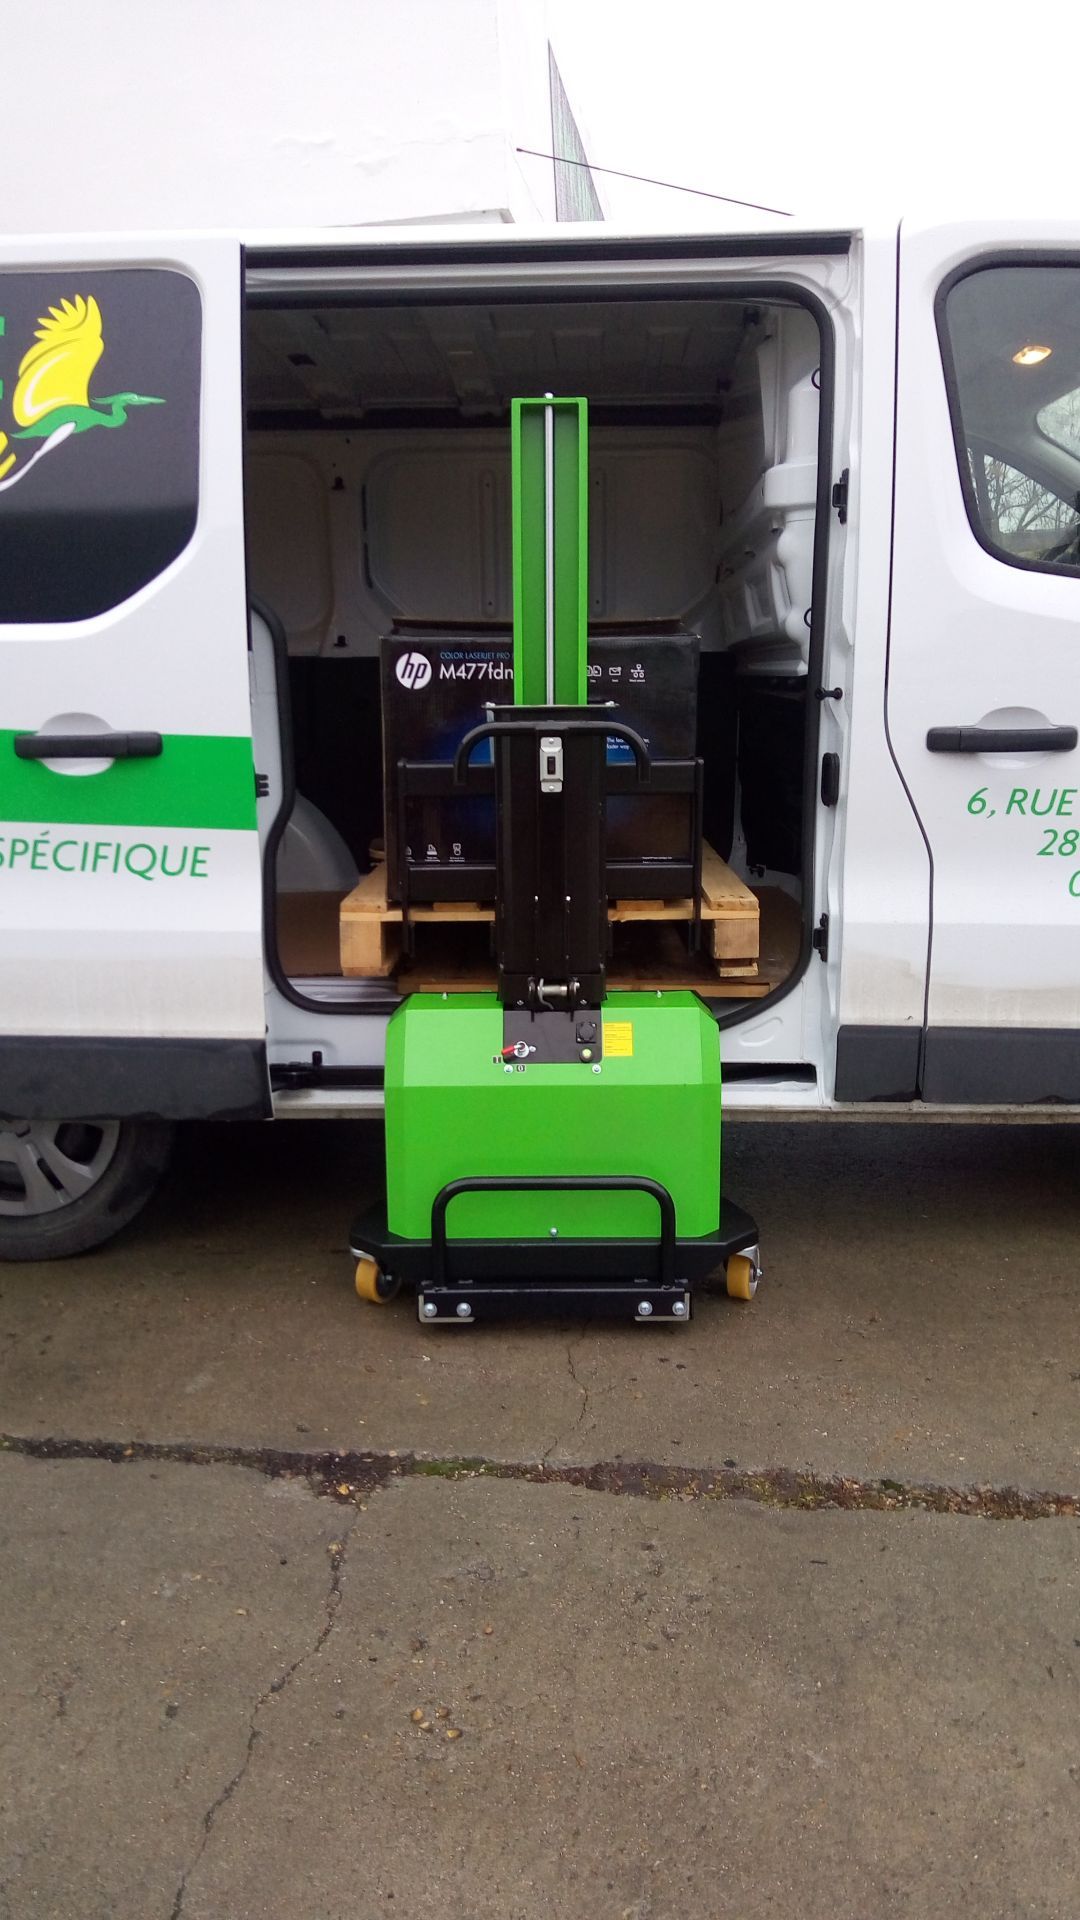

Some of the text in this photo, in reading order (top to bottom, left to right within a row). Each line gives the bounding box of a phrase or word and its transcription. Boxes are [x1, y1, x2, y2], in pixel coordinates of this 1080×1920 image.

[440, 651, 511, 660] COLOR LASERJET PRO
[399, 652, 430, 689] hp
[439, 661, 514, 680] M477fdn
[967, 787, 1078, 819] 6, RUE
[1036, 829, 1080, 857] 28
